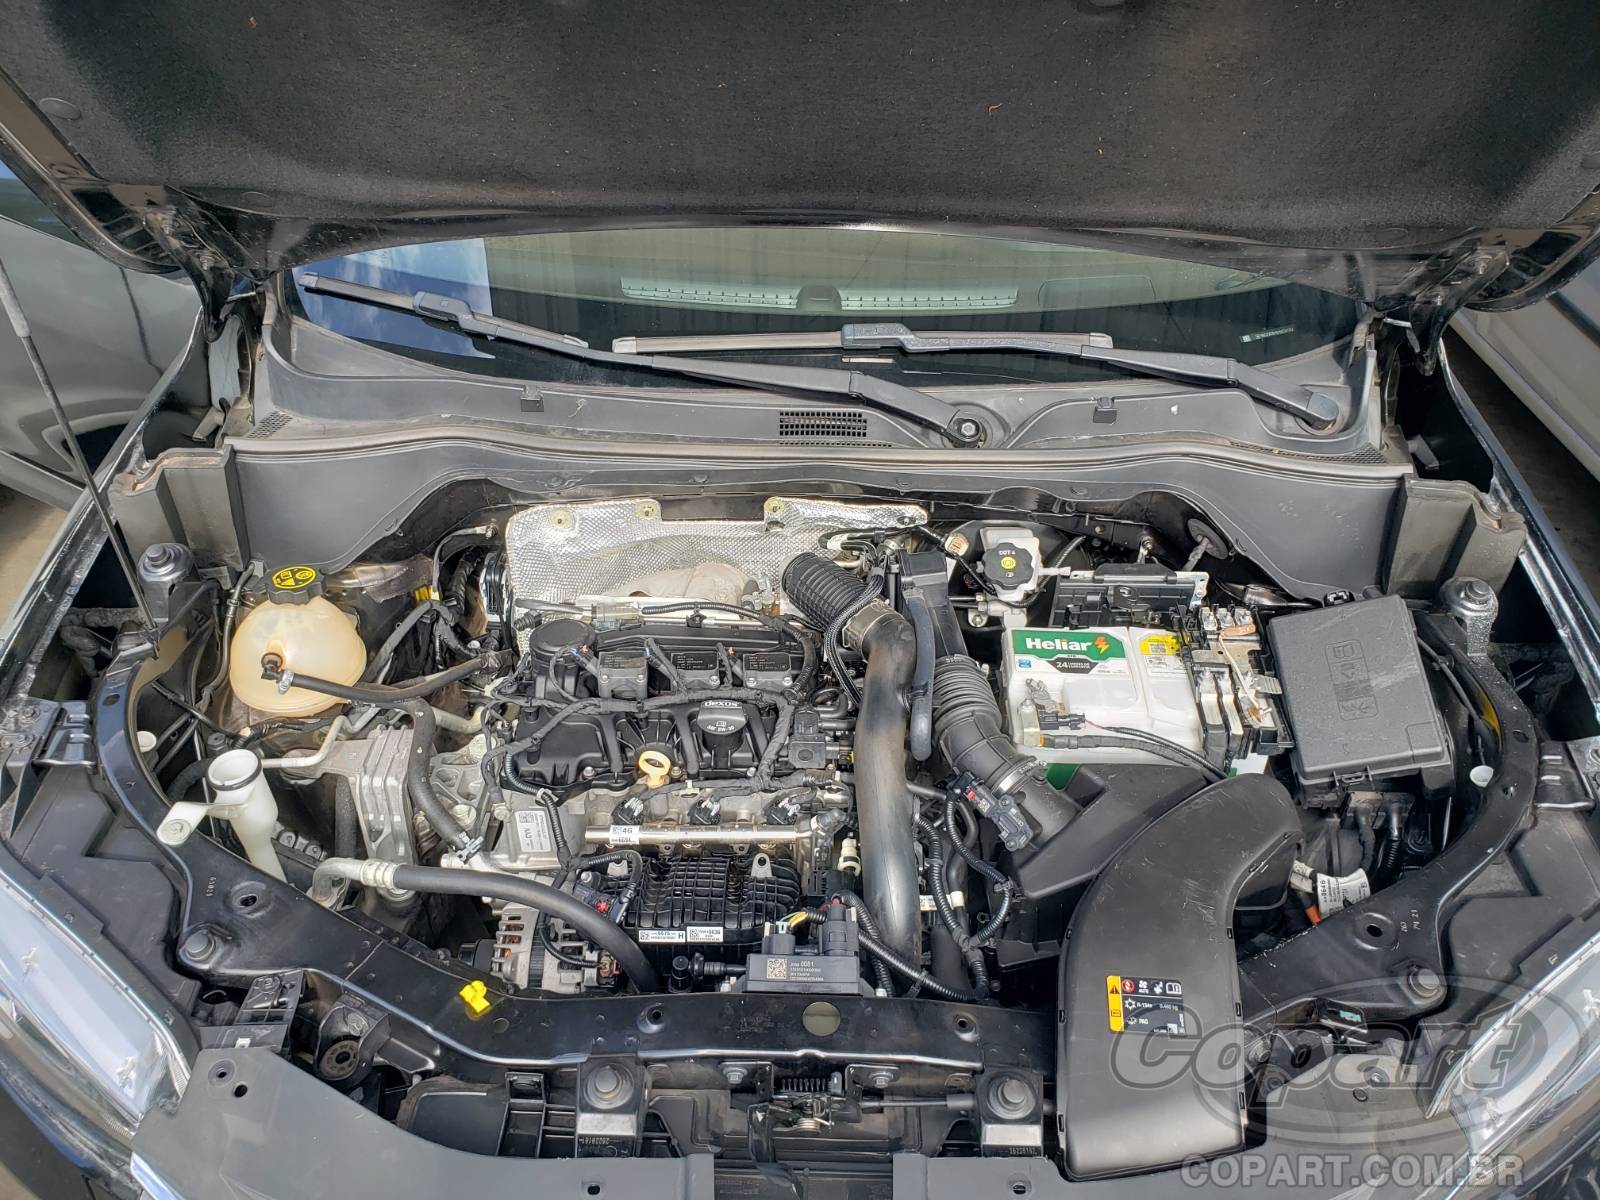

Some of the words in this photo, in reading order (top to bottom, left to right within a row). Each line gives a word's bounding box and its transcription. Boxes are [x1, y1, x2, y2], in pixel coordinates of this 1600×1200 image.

[1025, 637, 1092, 651] Heliar
[1056, 661, 1068, 669] 24
[678, 932, 684, 940] H
